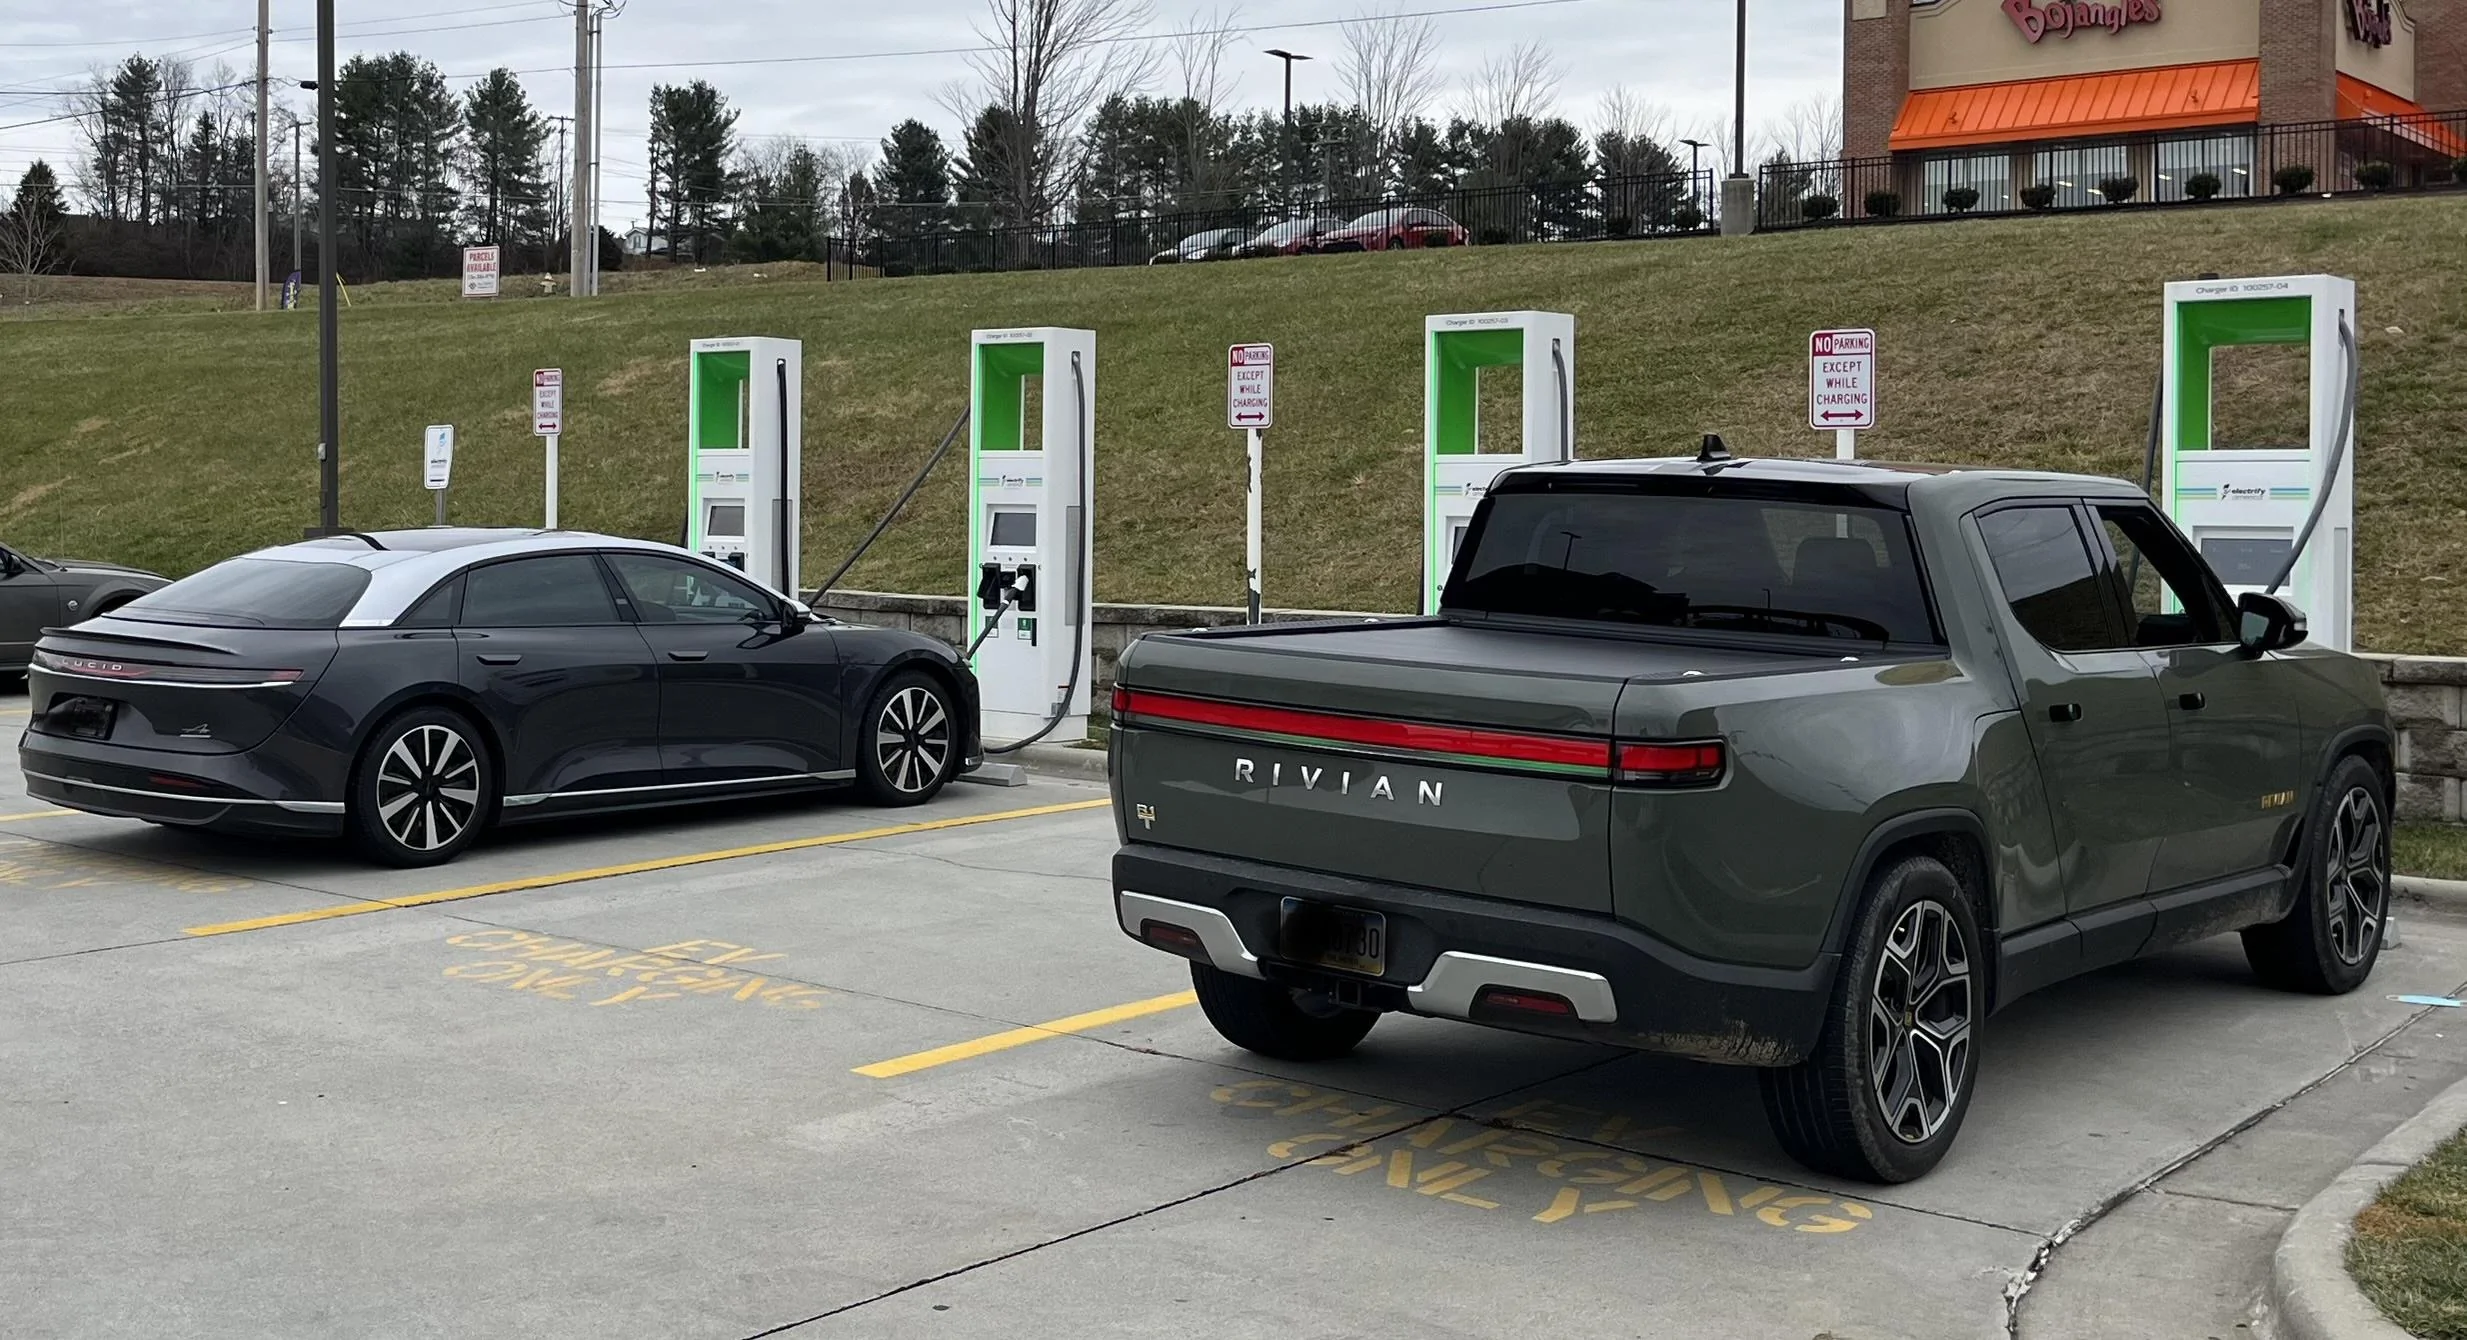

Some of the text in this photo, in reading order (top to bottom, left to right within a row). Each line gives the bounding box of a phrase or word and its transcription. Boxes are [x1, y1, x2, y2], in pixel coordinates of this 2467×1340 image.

[2243, 282, 2289, 292] 100257-04
[1446, 319, 1468, 327] Charger
[1815, 337, 1869, 353] NO PARKING
[1232, 349, 1269, 364] NO PARKING
[1822, 361, 1862, 373] EXCEPT
[1237, 371, 1264, 381] EXCEPT
[1240, 384, 1261, 394] WHILE
[1826, 377, 1858, 389] WHILE
[1233, 398, 1268, 408] CHARGING
[1816, 393, 1868, 405] CHARGING
[2231, 487, 2266, 496] electrify
[63, 658, 123, 671] LUCID
[1234, 758, 1443, 806] RIVIAN
[446, 930, 832, 1009] CHARGING
[442, 961, 683, 1007] ONLY
[1209, 1079, 1874, 1234] CHARGING
[1266, 1133, 1640, 1224] ONLY
